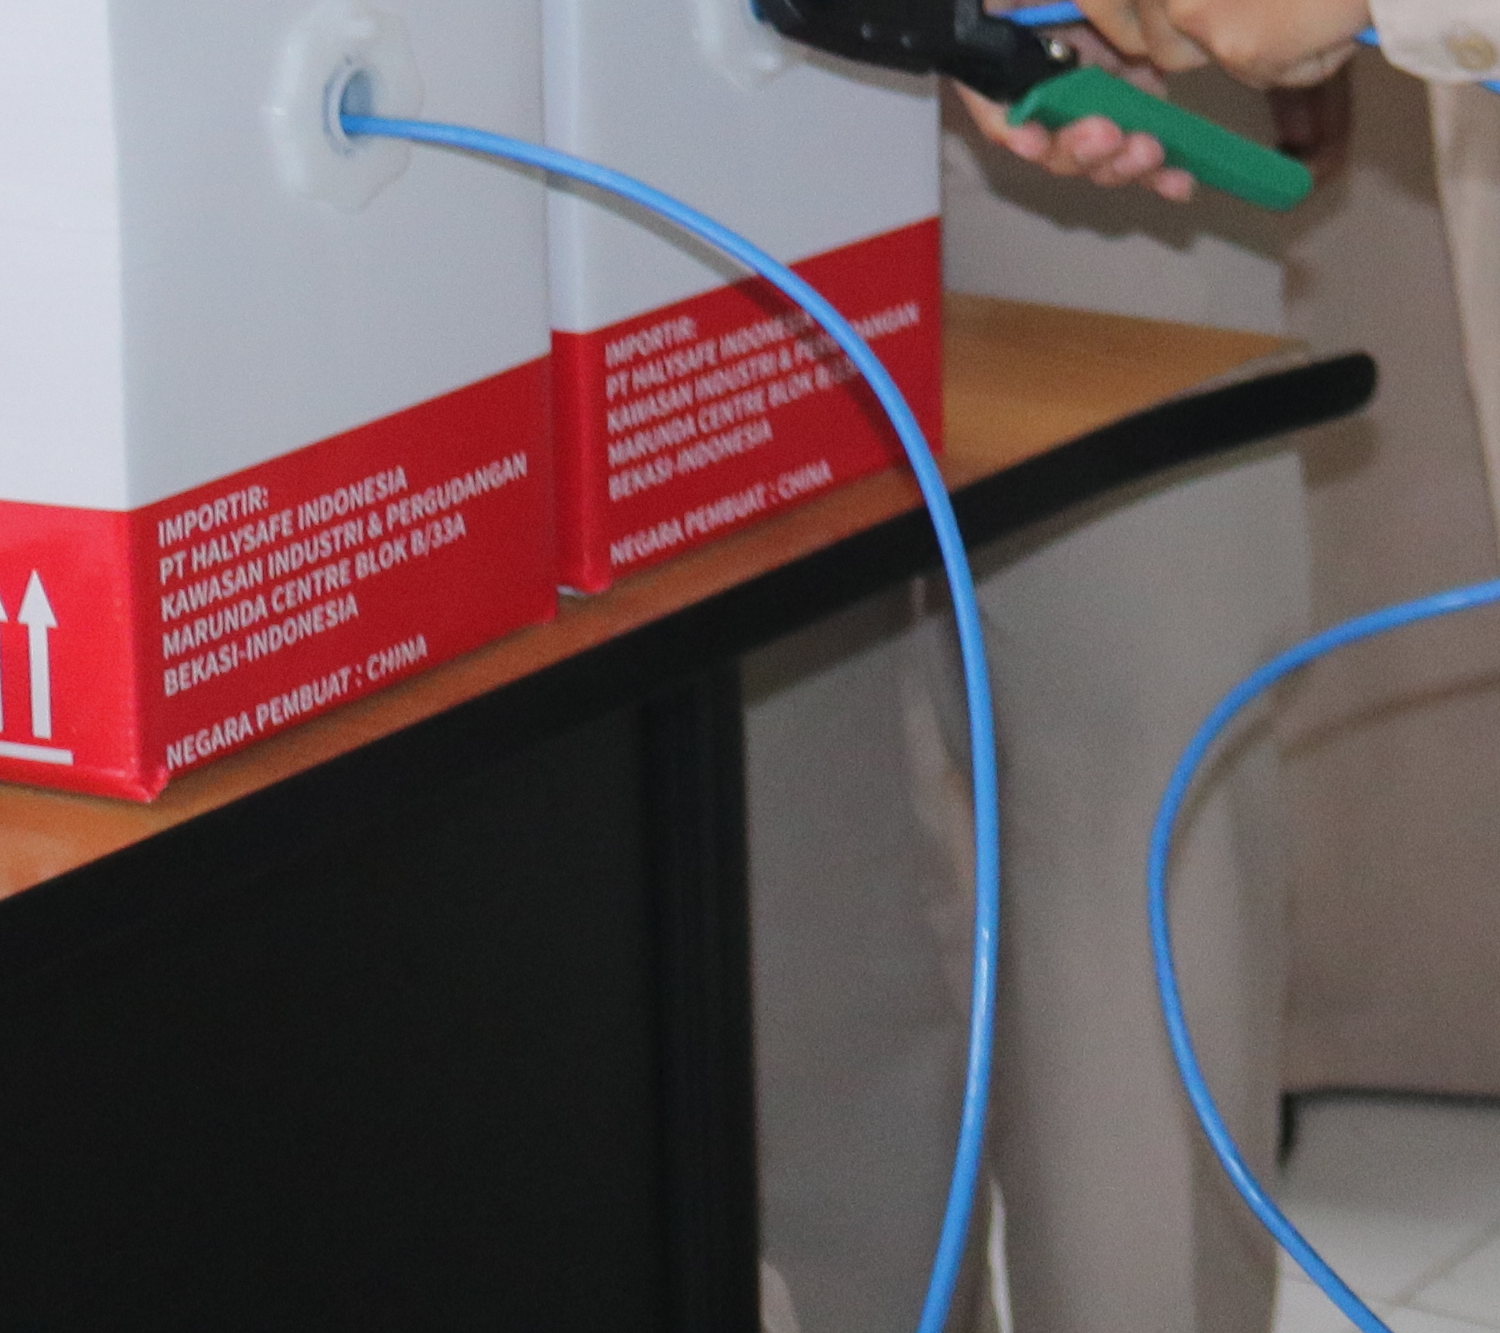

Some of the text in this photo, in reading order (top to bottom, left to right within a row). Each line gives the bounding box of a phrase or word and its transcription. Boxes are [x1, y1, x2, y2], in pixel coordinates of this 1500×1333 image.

[606, 371, 629, 401] PT
[158, 485, 269, 548] IMPORTIR:
[160, 465, 408, 585] PT HALYSAFE INDONESIA
[161, 451, 528, 622] KAWASAN INDUSTRI & PERGUDANGAN
[610, 518, 685, 566] NEGARA
[163, 513, 466, 659] MARUNDA CENTRE BLOK B/33A
[164, 592, 359, 696] BEKASI-INDONESIA
[166, 712, 253, 770] NEGARA
[256, 664, 350, 732] PEMBUAT
[366, 634, 428, 681] CHINA
